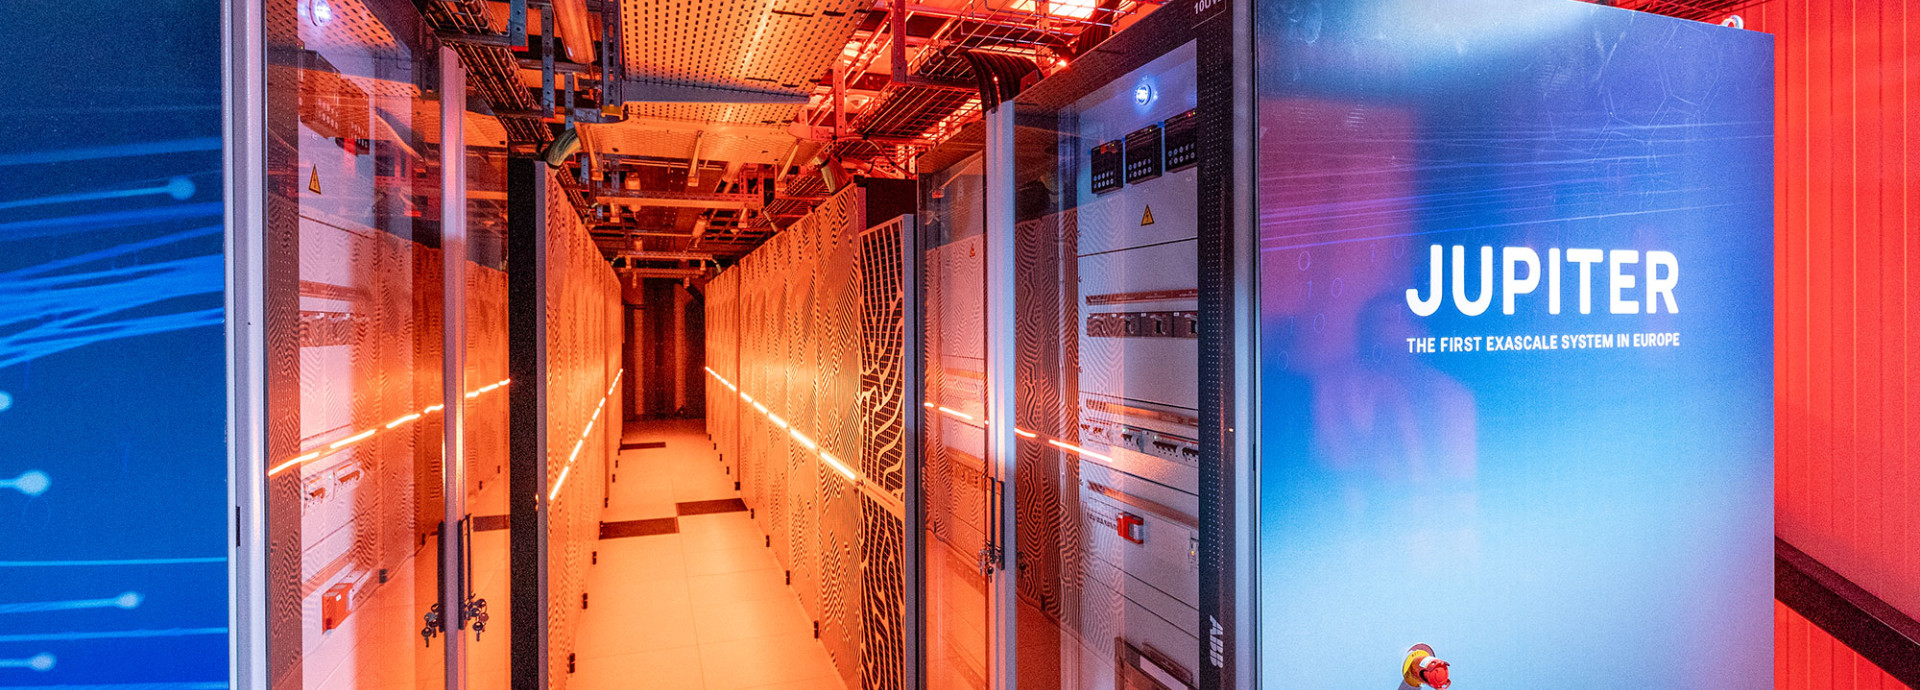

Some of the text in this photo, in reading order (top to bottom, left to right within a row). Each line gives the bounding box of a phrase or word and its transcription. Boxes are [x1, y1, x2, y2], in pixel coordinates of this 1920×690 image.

[1194, 0, 1221, 14] 10U
[1406, 244, 1679, 317] JUPITER
[1406, 332, 1681, 353] THE FIRST EXASCALE SYSTEM IN EUROPE
[1210, 615, 1223, 669] ABB
